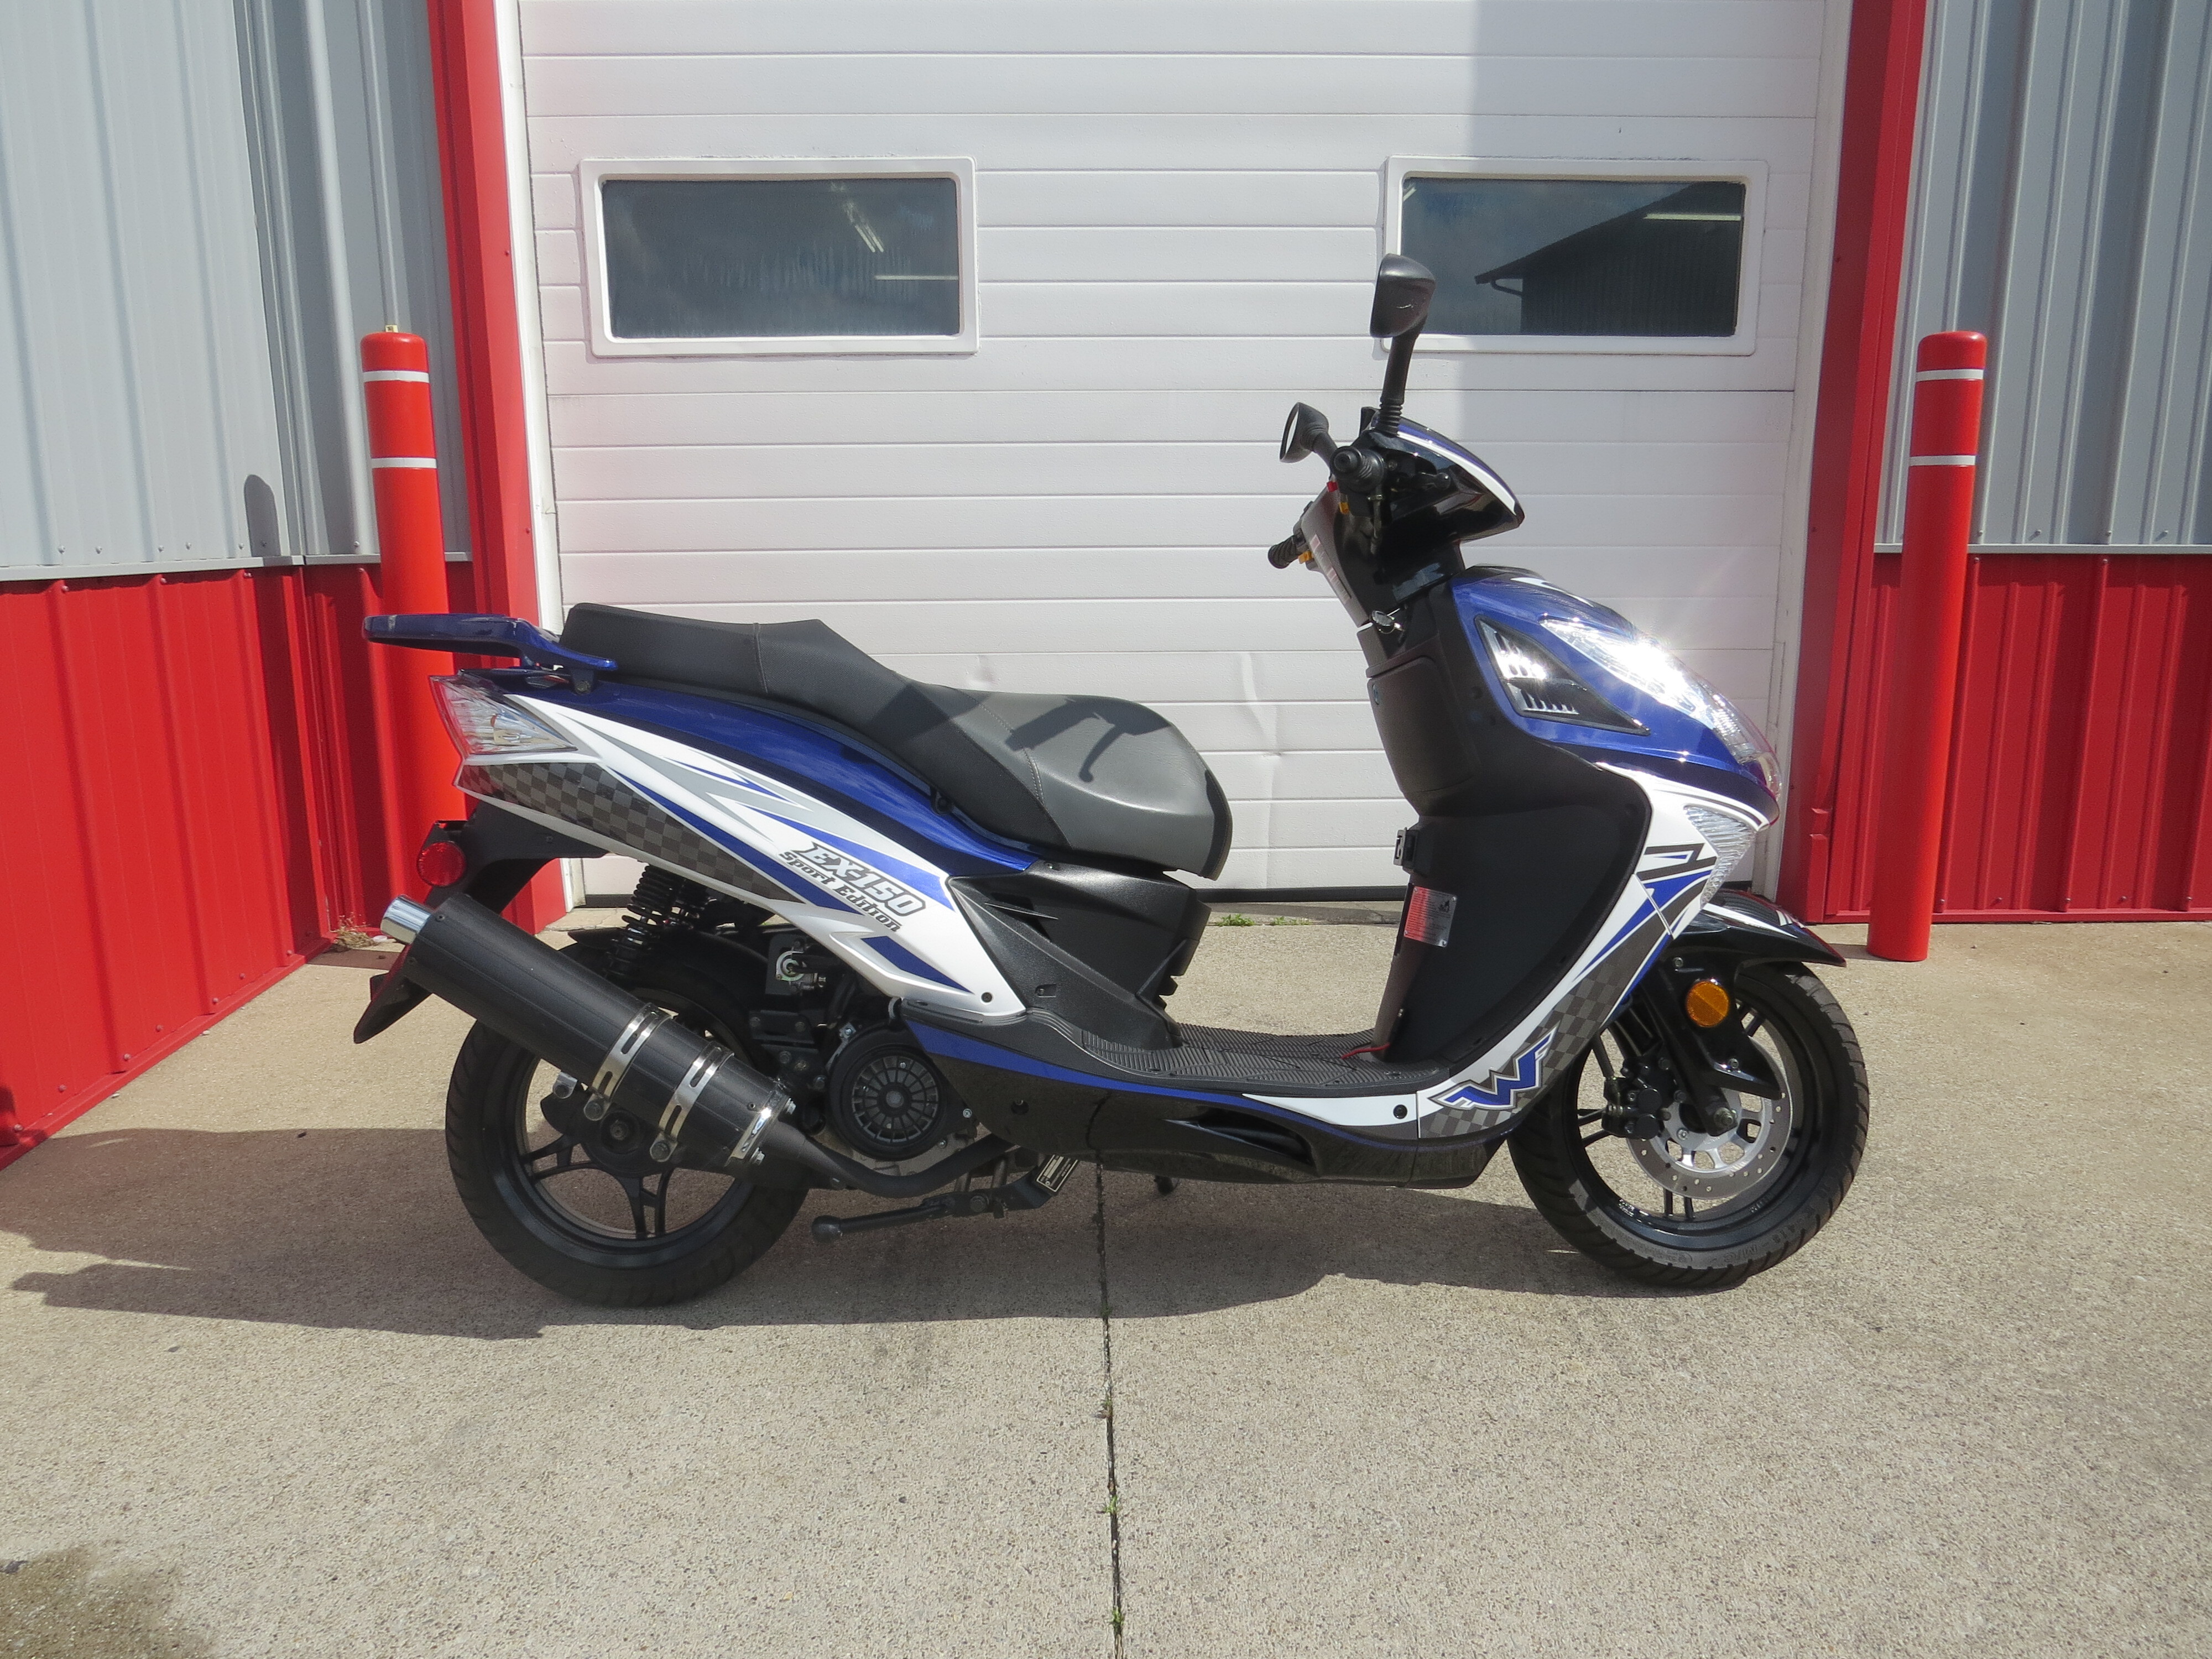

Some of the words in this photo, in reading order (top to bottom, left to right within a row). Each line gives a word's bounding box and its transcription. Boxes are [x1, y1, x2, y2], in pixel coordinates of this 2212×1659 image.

[779, 852, 835, 884] Sport
[834, 885, 902, 932] Edition
[793, 842, 926, 916] EX-150
